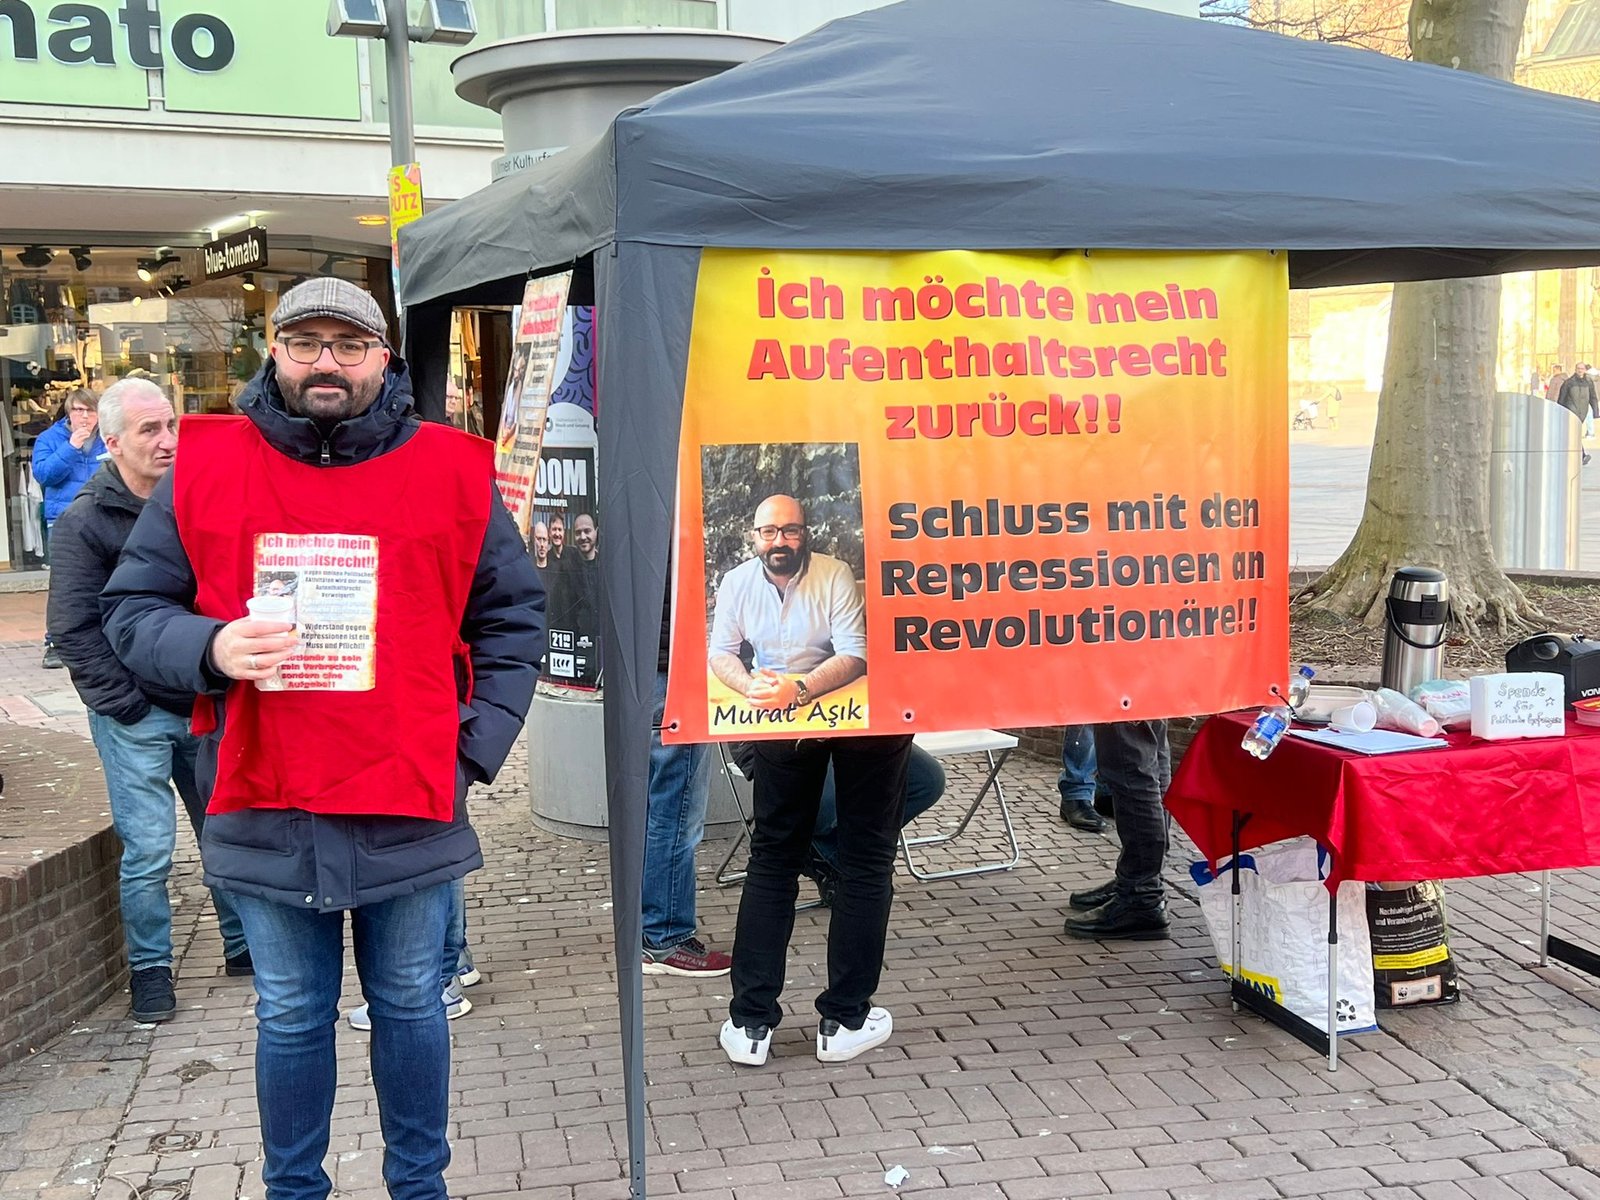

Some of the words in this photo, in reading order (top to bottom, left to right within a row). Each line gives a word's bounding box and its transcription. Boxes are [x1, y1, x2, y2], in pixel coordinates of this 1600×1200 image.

[391, 192, 418, 212] UTZ
[204, 234, 260, 275] blue-tomato
[861, 275, 1074, 322] möchte
[1087, 283, 1219, 324] mein
[746, 335, 1228, 382] Aufenthaltsrecht
[884, 392, 1122, 440] zurück!!
[887, 497, 1090, 541] Schluss
[1106, 493, 1187, 532] mit
[1200, 491, 1259, 529] den
[263, 535, 283, 548] Ich
[338, 537, 371, 550] mein
[881, 549, 1220, 600] Repressionen
[1231, 550, 1266, 582] an
[301, 632, 348, 640] Repressionen
[893, 596, 1258, 653] Revolutionäre!!
[713, 702, 798, 726] Murat
[806, 697, 863, 728] Aşık
